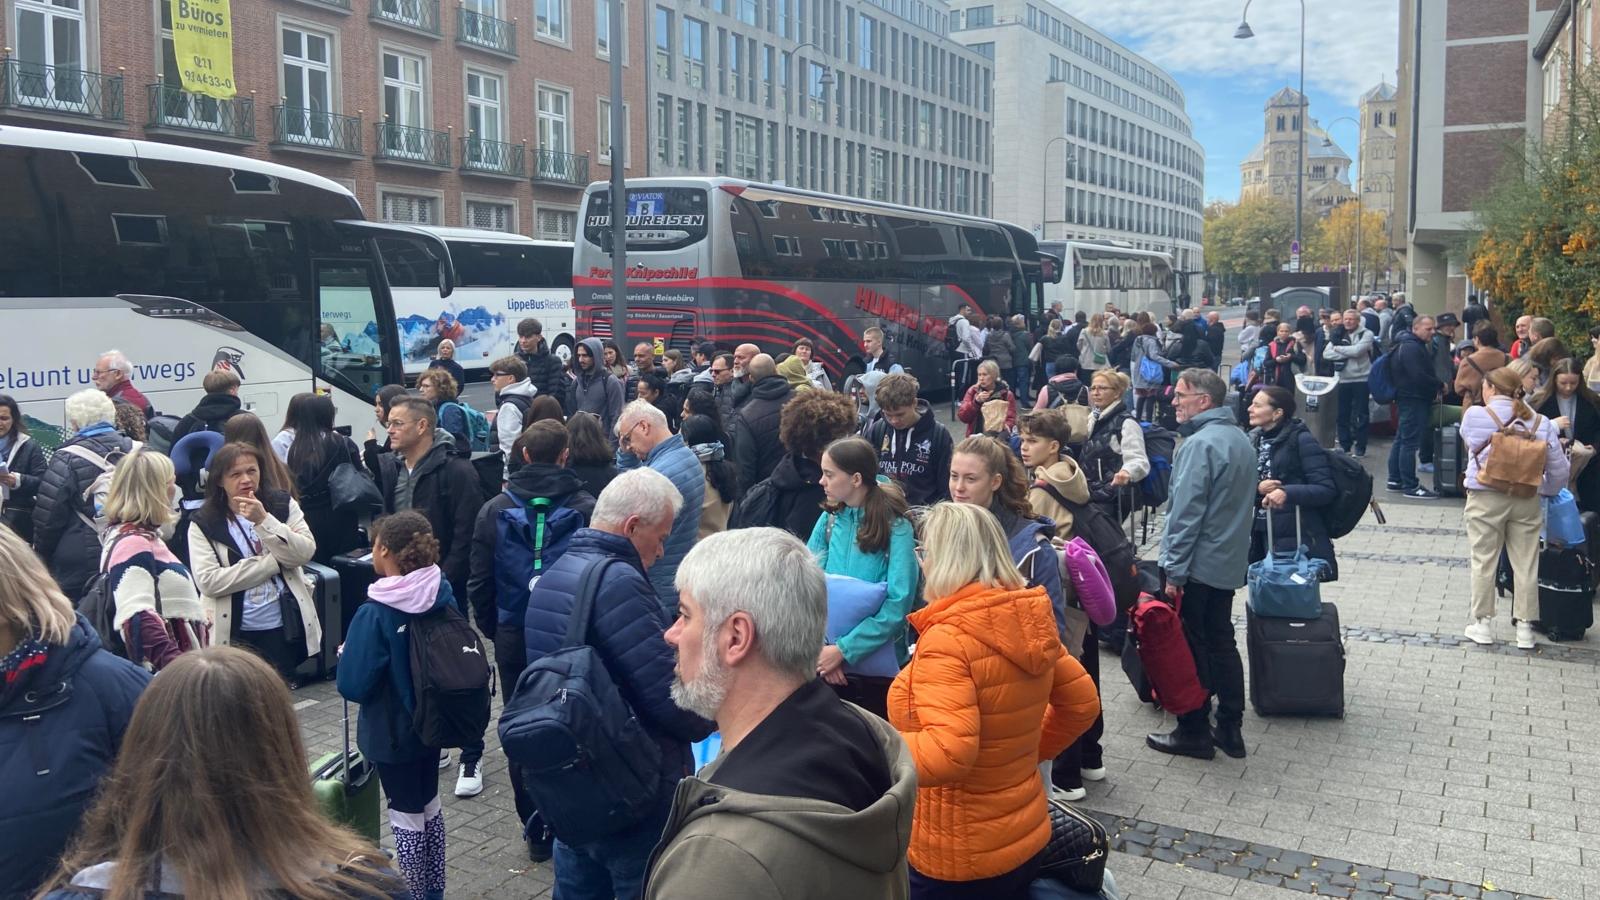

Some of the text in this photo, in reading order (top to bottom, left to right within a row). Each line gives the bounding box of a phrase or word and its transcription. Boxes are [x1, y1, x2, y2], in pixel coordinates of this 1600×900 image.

[179, 0, 224, 26] Büros
[176, 22, 228, 39] zu vermieten
[590, 267, 698, 281] Fer Knipschild
[655, 293, 695, 303] Reisebüro
[322, 311, 352, 319] terwegs
[879, 461, 898, 470] OYAL
[902, 461, 925, 473] POLO
